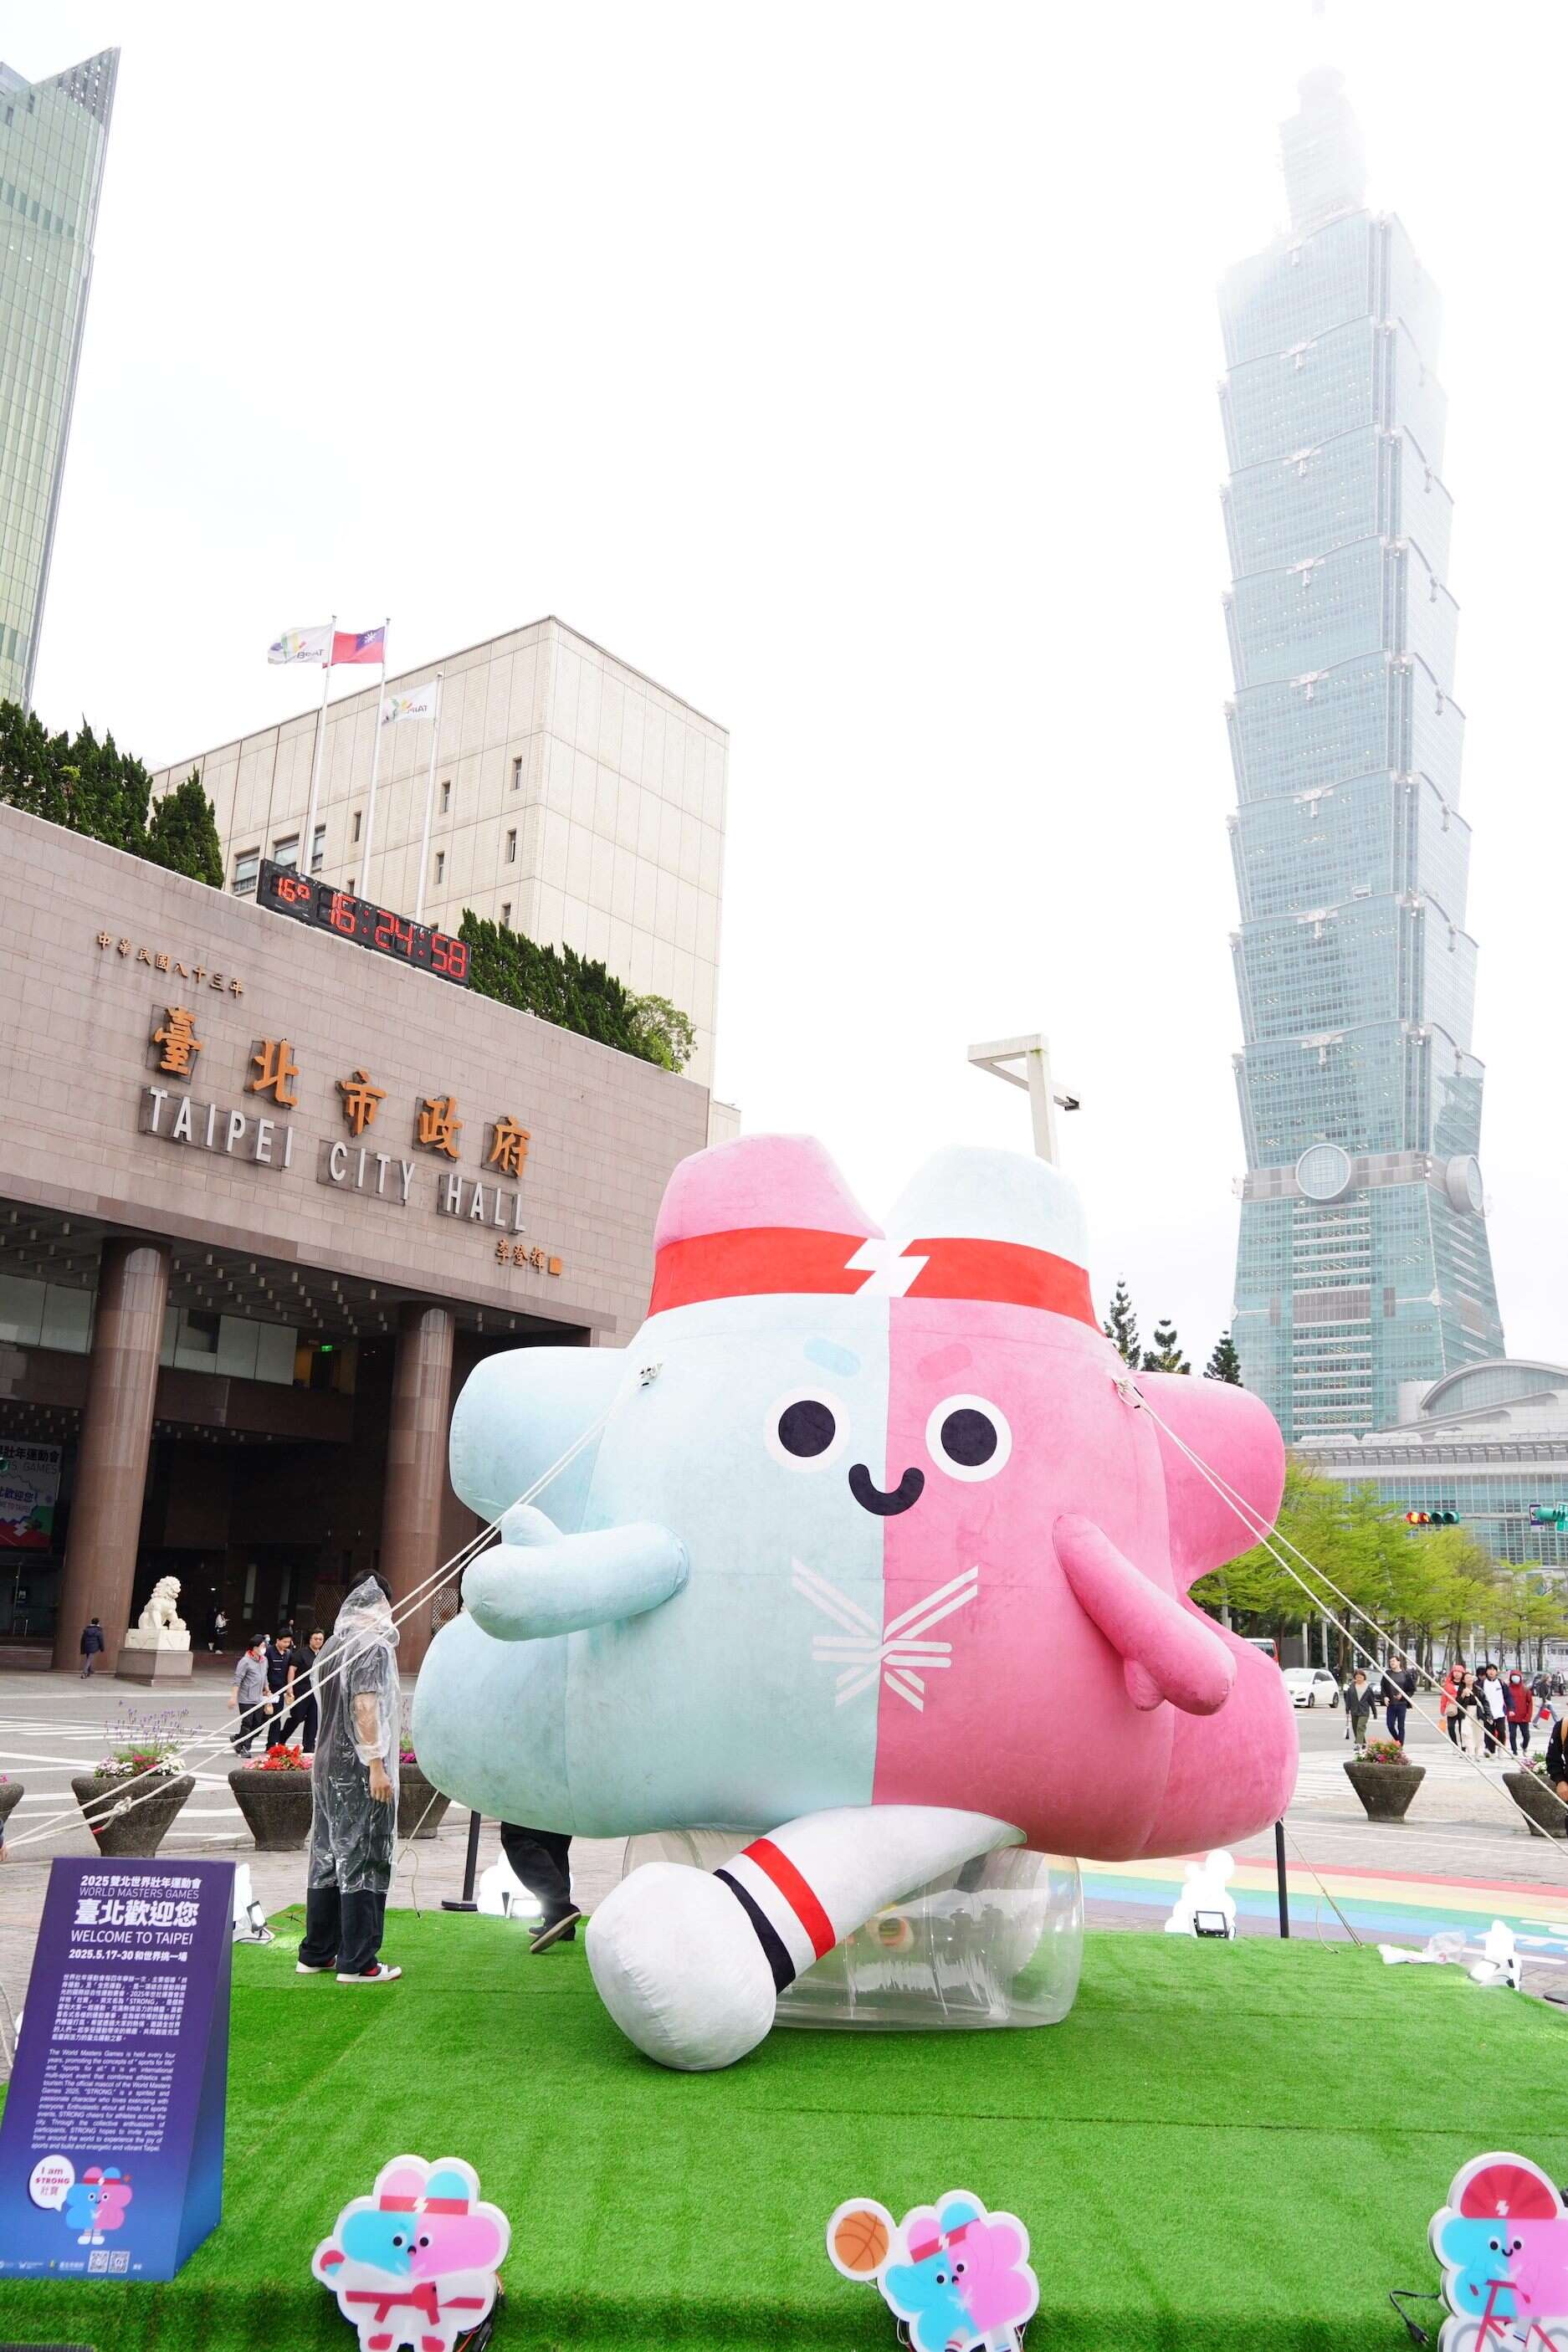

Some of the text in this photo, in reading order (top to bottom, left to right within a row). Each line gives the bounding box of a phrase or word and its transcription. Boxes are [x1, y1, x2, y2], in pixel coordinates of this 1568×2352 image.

[96, 931, 245, 998] 中華民國八十三年
[153, 1006, 531, 1179] 臺北市政府
[149, 1086, 526, 1232] TAIPEI CITY HALL
[74, 1898, 200, 1927] 臺北歡迎您
[79, 1887, 199, 1899] WORLD MASTERS GAMES
[71, 1929, 193, 1945] WELCOME TO TAIPEI
